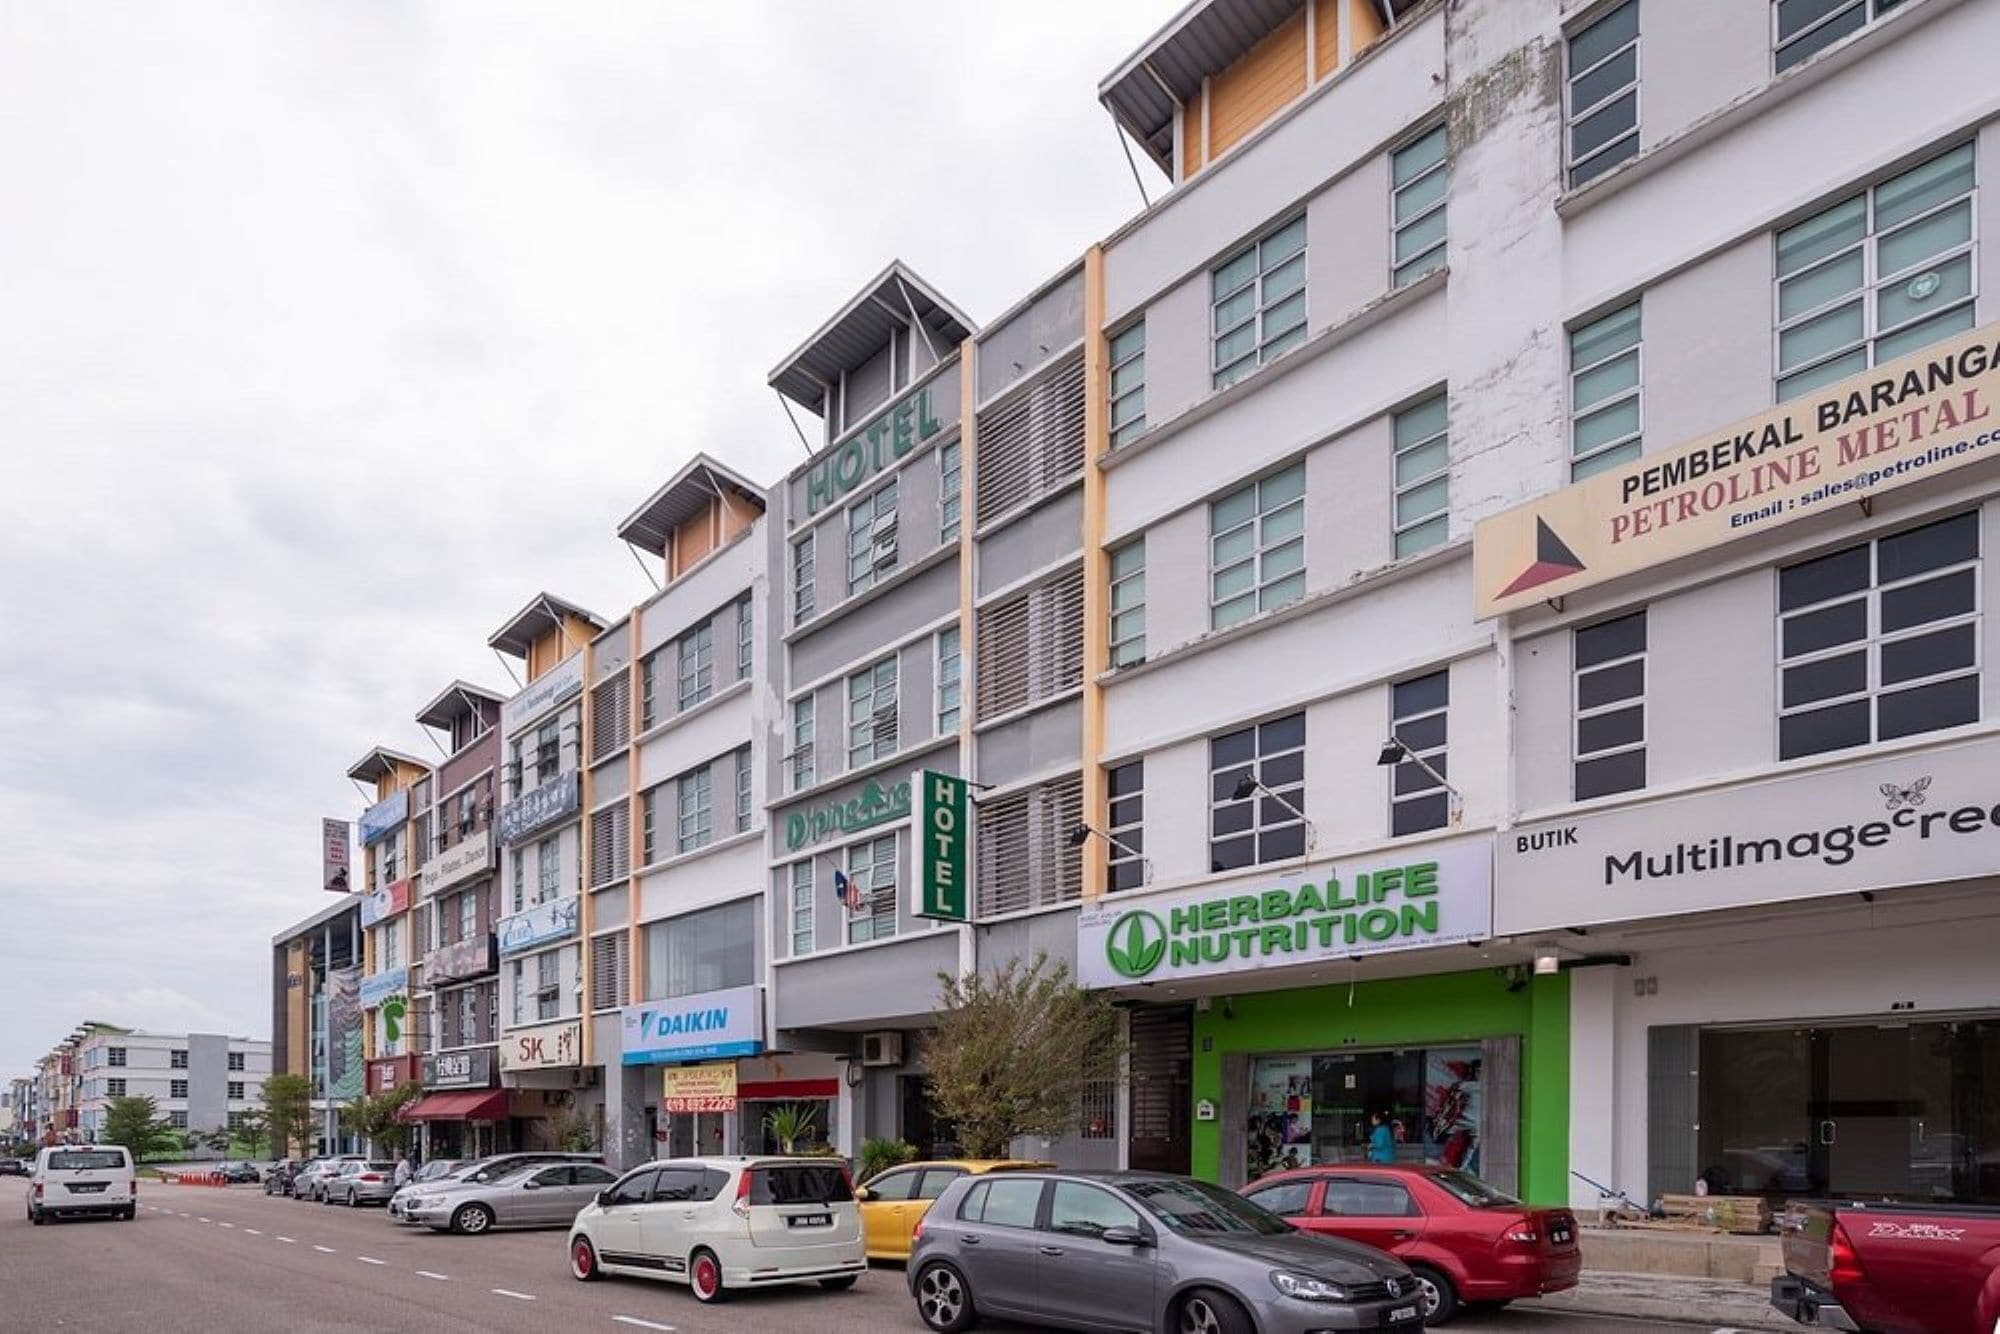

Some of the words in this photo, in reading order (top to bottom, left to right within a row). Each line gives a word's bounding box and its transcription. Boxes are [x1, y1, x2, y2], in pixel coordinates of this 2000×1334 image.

[807, 387, 941, 517] HOTEL
[1610, 444, 1822, 545] PETROLINE
[1835, 387, 1991, 468] METAL
[1622, 416, 1804, 505] PEMBEKAL
[1729, 500, 1784, 529] Email
[934, 778, 955, 913] HOTEL
[1515, 826, 1579, 854] BUTIK
[1170, 861, 1440, 936] HERBALIFE
[1170, 900, 1440, 968] NUTRITION
[518, 1037, 545, 1063] SK
[657, 1007, 729, 1036] DAIKIN
